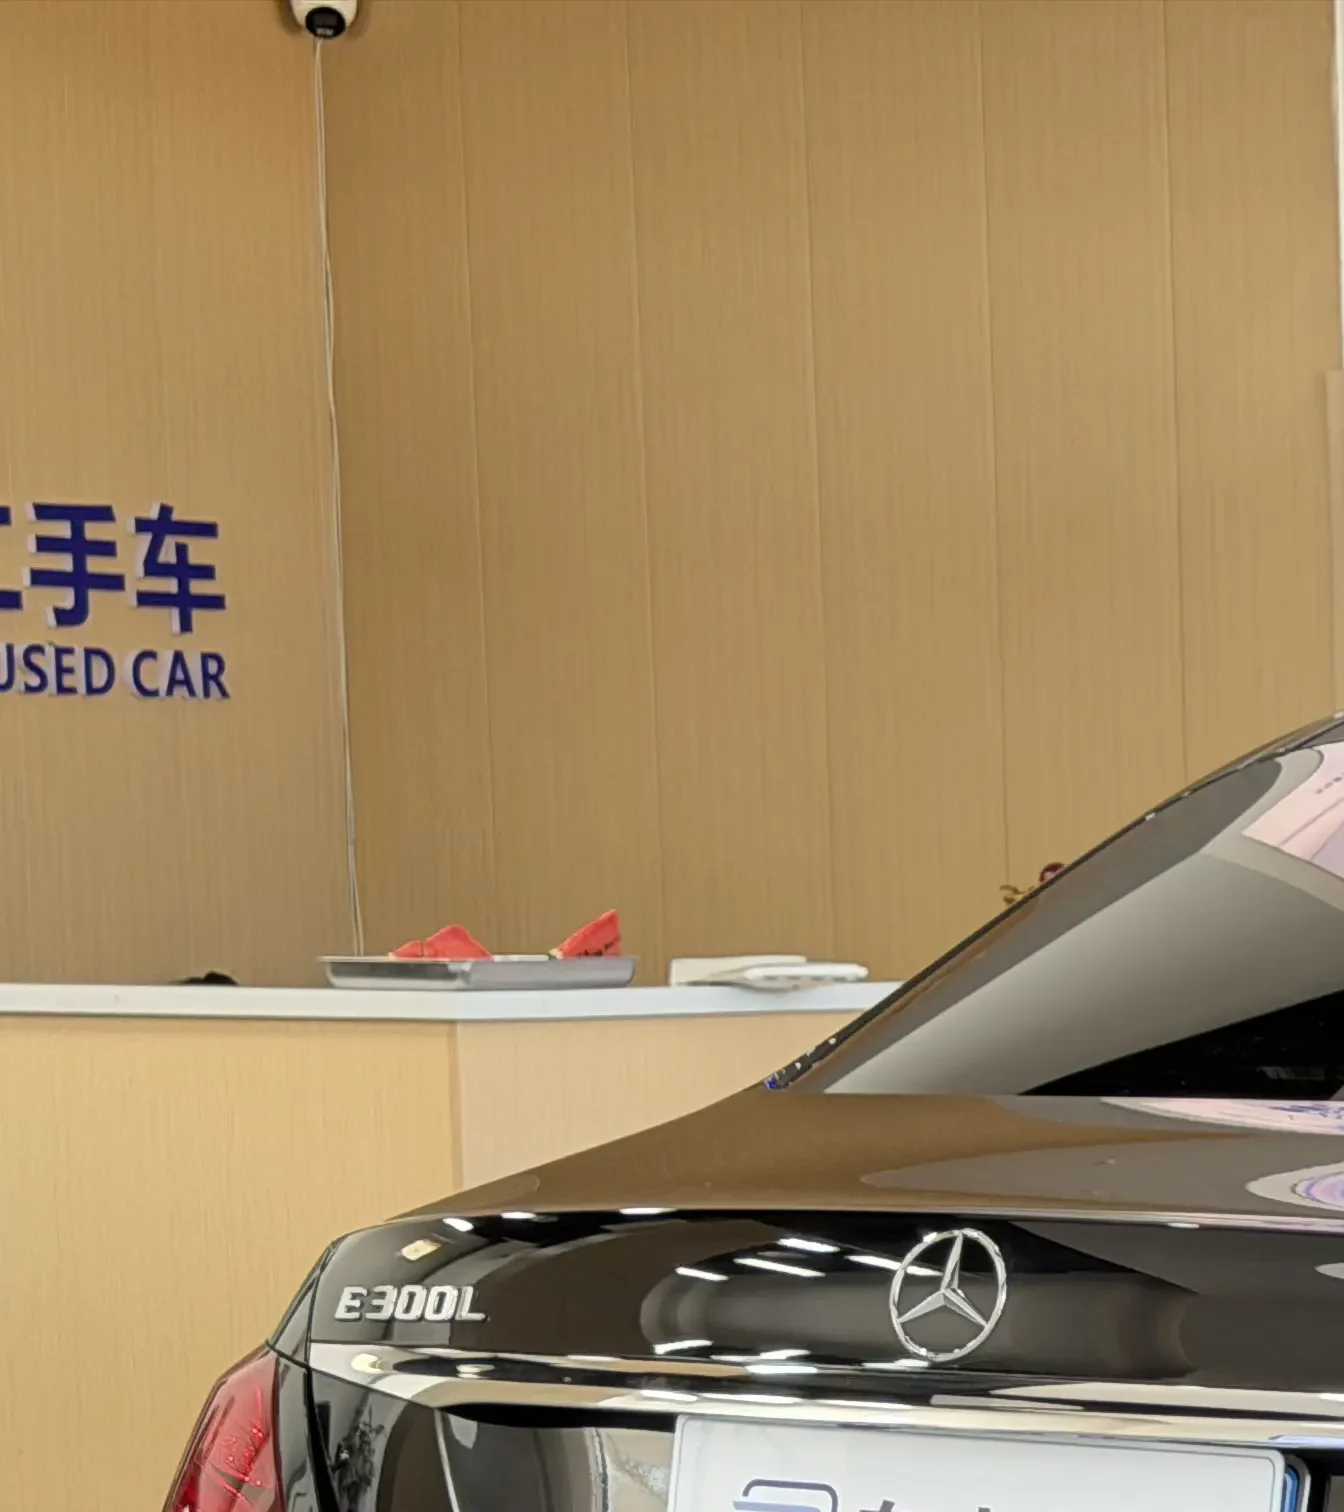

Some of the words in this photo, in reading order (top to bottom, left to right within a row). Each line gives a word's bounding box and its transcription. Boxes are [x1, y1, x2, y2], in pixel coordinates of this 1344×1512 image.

[0, 502, 226, 634] 手车
[131, 649, 231, 699] CAR
[334, 1284, 486, 1321] E300L
